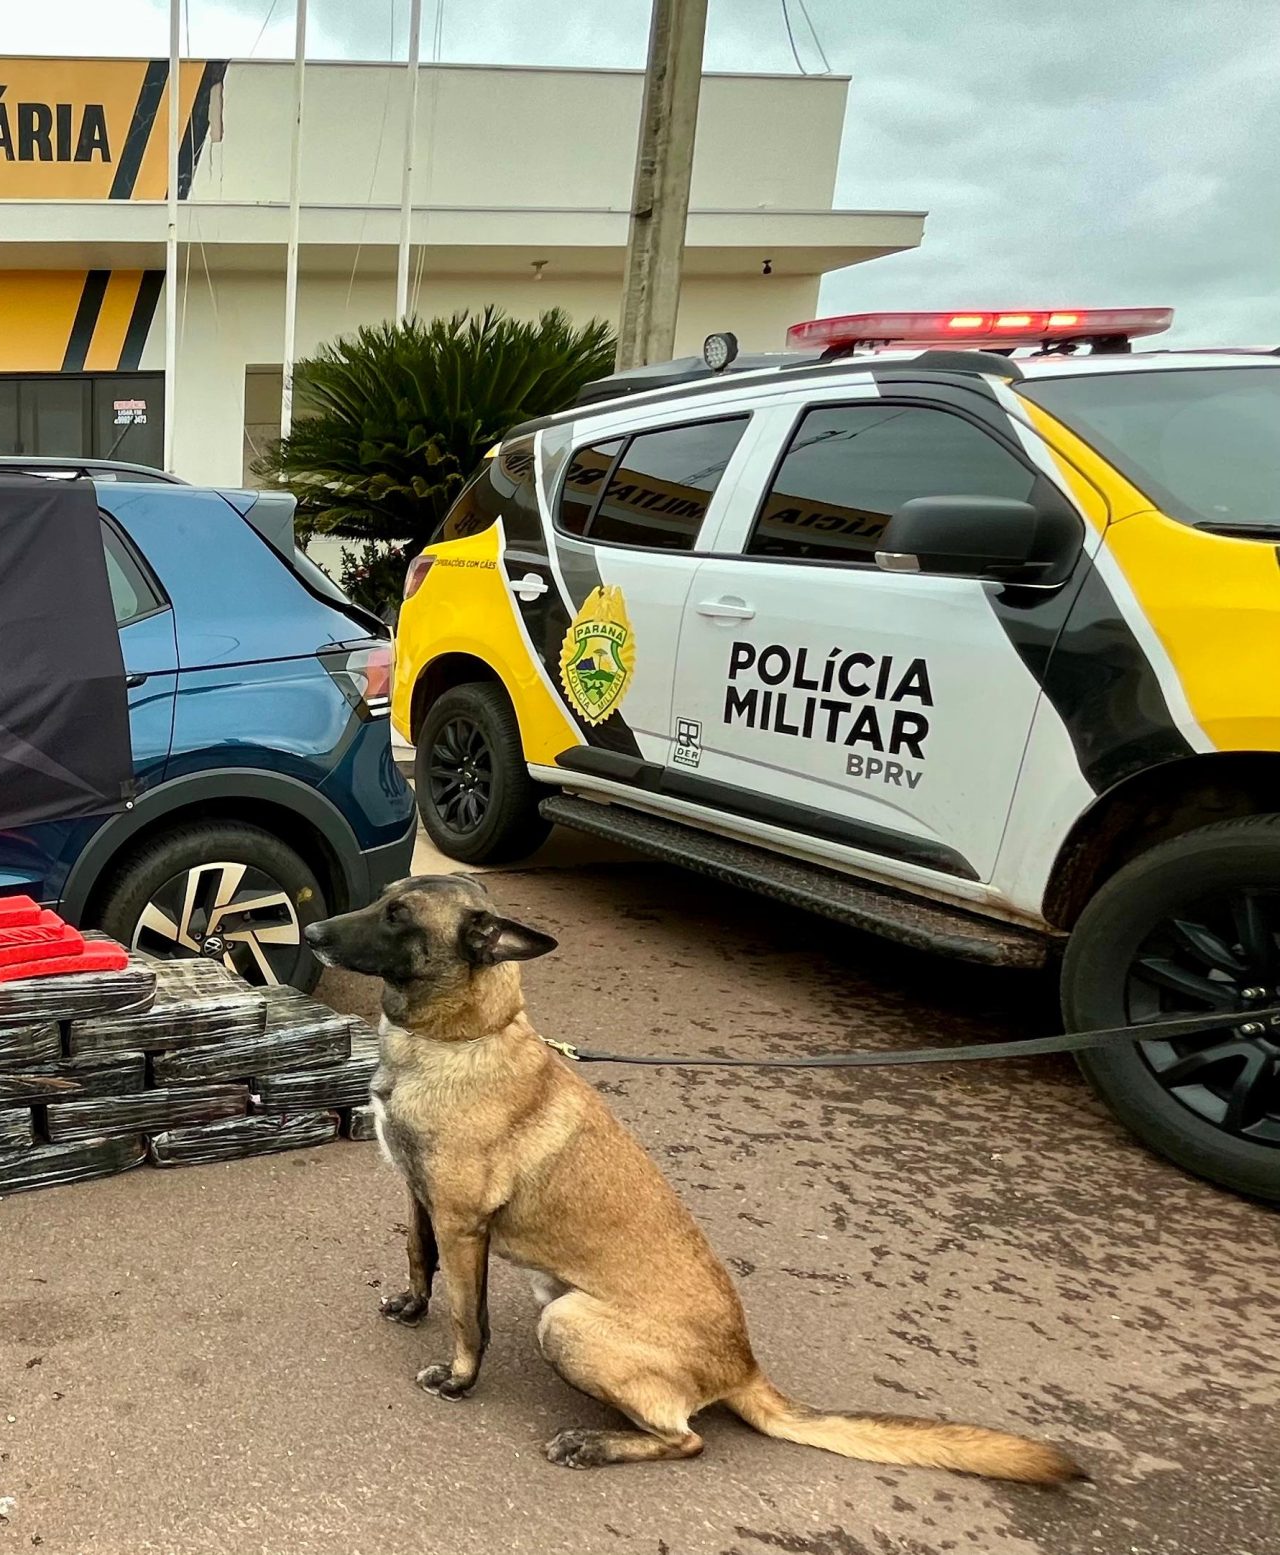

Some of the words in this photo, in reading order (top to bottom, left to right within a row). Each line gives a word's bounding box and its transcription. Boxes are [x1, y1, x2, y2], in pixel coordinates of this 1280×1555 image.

[576, 624, 624, 642] PARANÁ
[597, 673, 623, 712] MILITAR
[723, 685, 929, 760] MILITAR
[677, 747, 699, 760] DER
